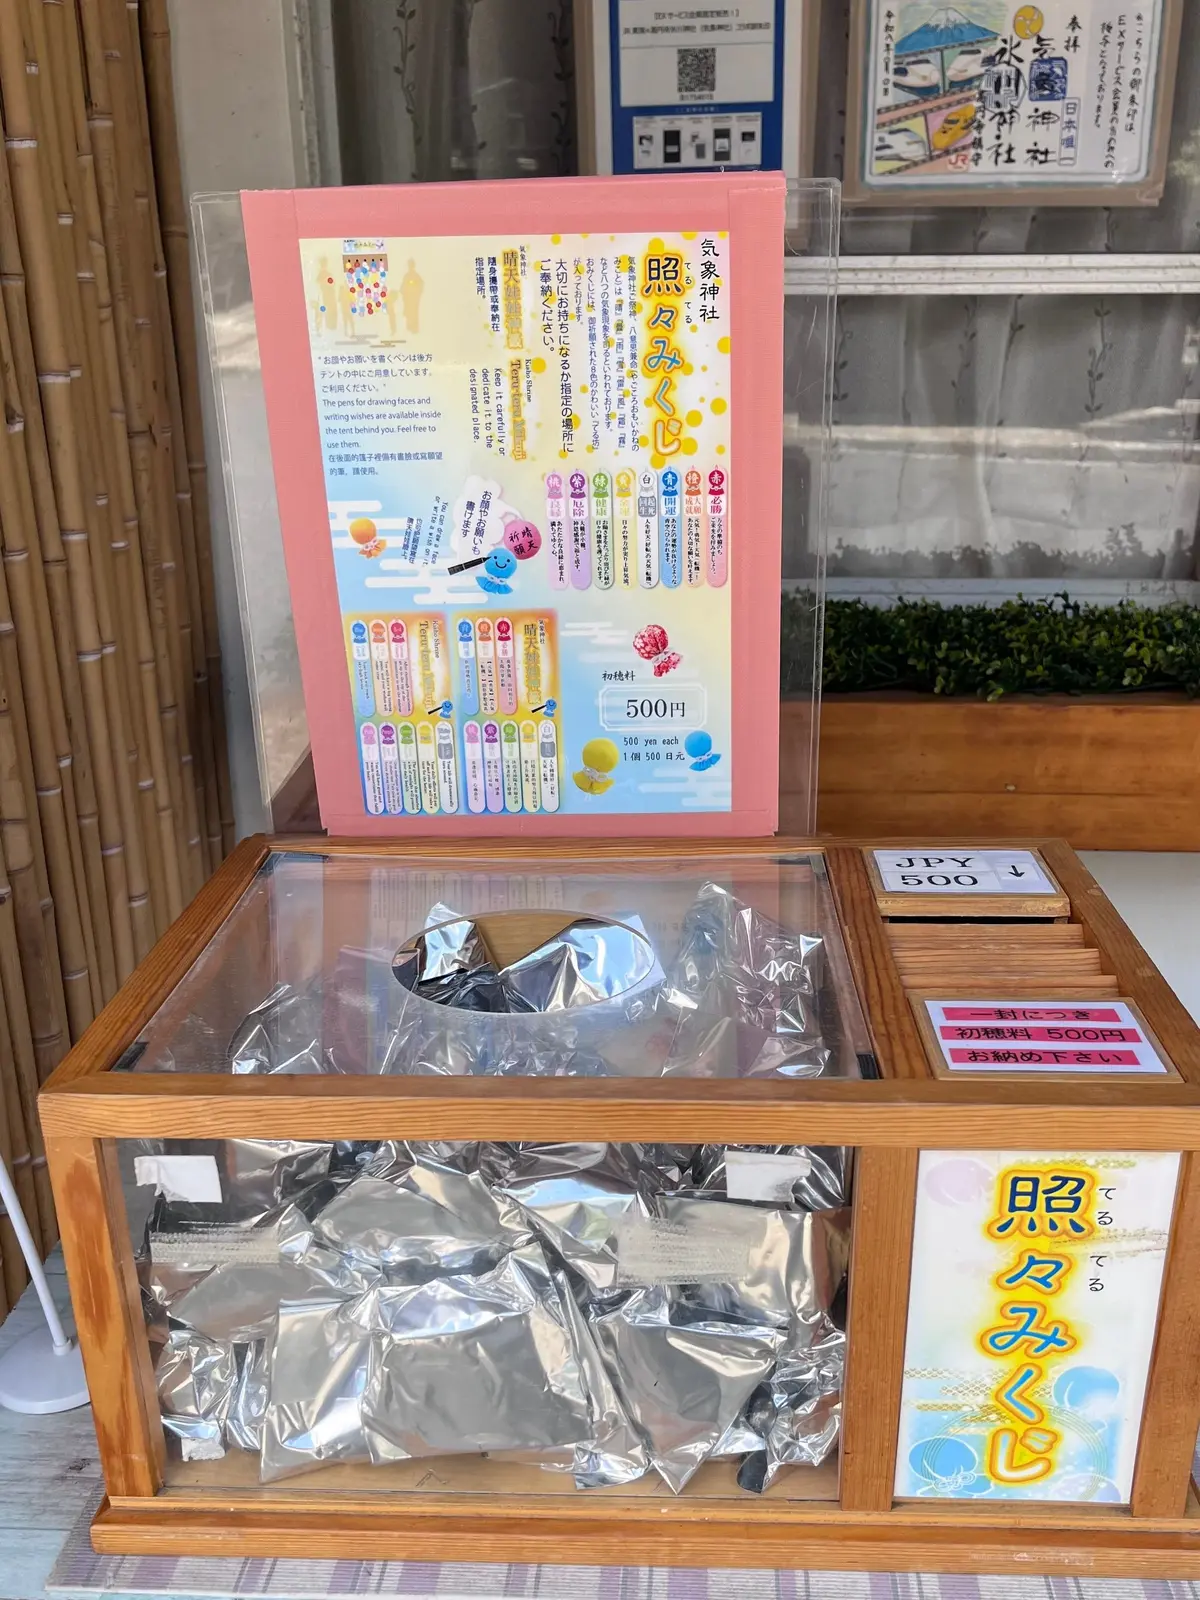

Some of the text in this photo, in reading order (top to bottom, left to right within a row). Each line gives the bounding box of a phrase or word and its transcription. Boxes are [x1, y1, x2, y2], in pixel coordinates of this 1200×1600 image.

[948, 154, 968, 166] JR
[699, 238, 720, 322] 気象神社
[684, 262, 693, 324] てる てる
[540, 259, 555, 352] ご奉納ください。
[555, 259, 574, 453] 大切にお持ちになるか指定の場所に
[642, 254, 684, 457] 照々みくじ
[482, 368, 490, 404] dedicate
[526, 379, 534, 403] Shrine
[323, 397, 431, 408] The pens for drawing faces and
[469, 368, 480, 443] designated place.
[324, 412, 349, 422] writing
[350, 411, 374, 420] wishes
[388, 410, 419, 419] available
[420, 410, 442, 419] inside
[495, 404, 505, 444] carefully
[326, 426, 337, 435] the
[338, 426, 353, 435] tent
[354, 425, 379, 434] behind
[397, 425, 412, 433] Feel
[413, 424, 427, 433] free
[327, 440, 361, 449] use them.
[664, 497, 677, 516] 開運
[710, 496, 722, 515] 必勝
[461, 500, 476, 538] 書けます
[471, 490, 493, 556] お顔やお願いも
[601, 670, 636, 682] 初穂料
[626, 698, 686, 719] 500円
[623, 736, 679, 747] 500 yen each
[645, 751, 661, 761] 500
[666, 751, 685, 761] 日元
[895, 857, 976, 869] JPY
[901, 874, 979, 887] 500
[969, 1009, 1092, 1021] 一封につき
[955, 1027, 1127, 1042] 初穂料 500円
[967, 1050, 1124, 1063] お納め下さい
[1088, 1186, 1118, 1293] てる てる
[981, 1170, 1093, 1484] 照々みくじ
